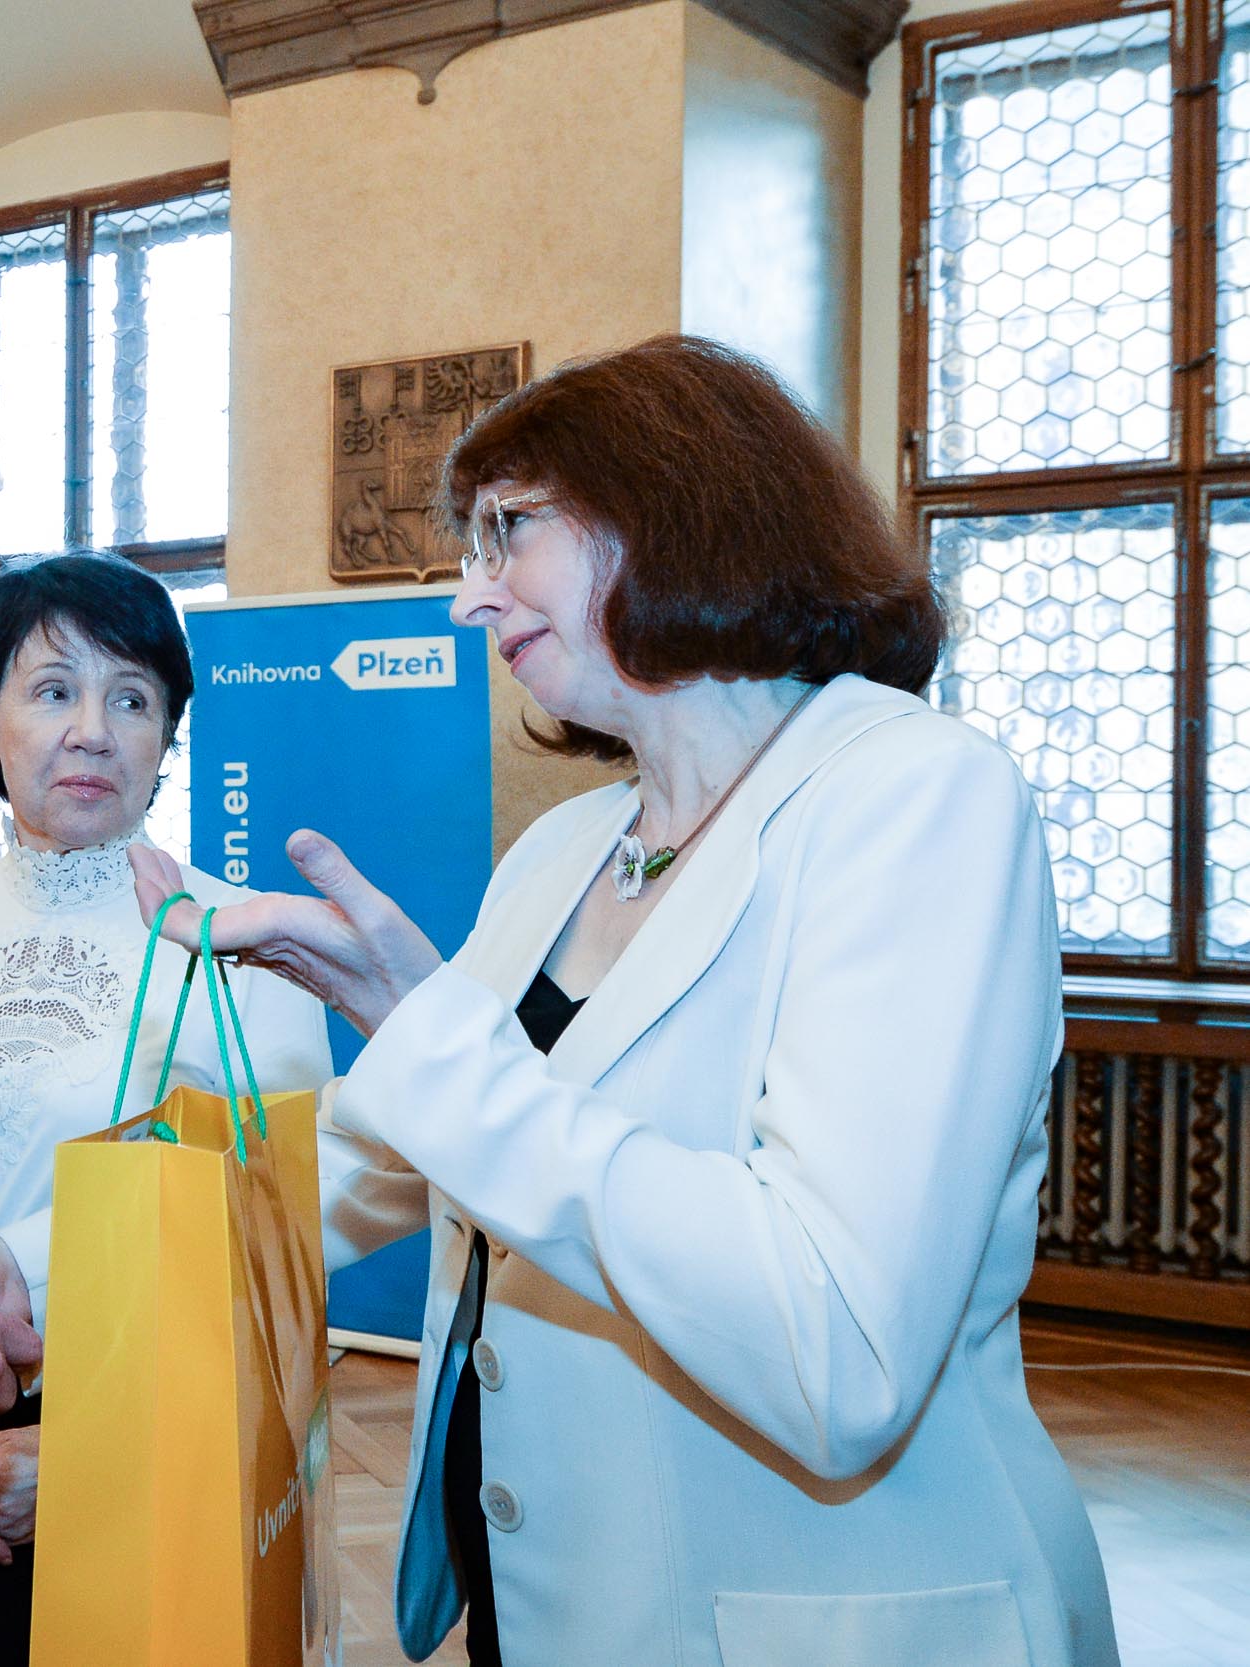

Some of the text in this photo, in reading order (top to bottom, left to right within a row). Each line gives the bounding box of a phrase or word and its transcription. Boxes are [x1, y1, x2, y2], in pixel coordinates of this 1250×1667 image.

[211, 647, 444, 686] Knihovna Plzeň
[223, 762, 249, 888] en.eu
